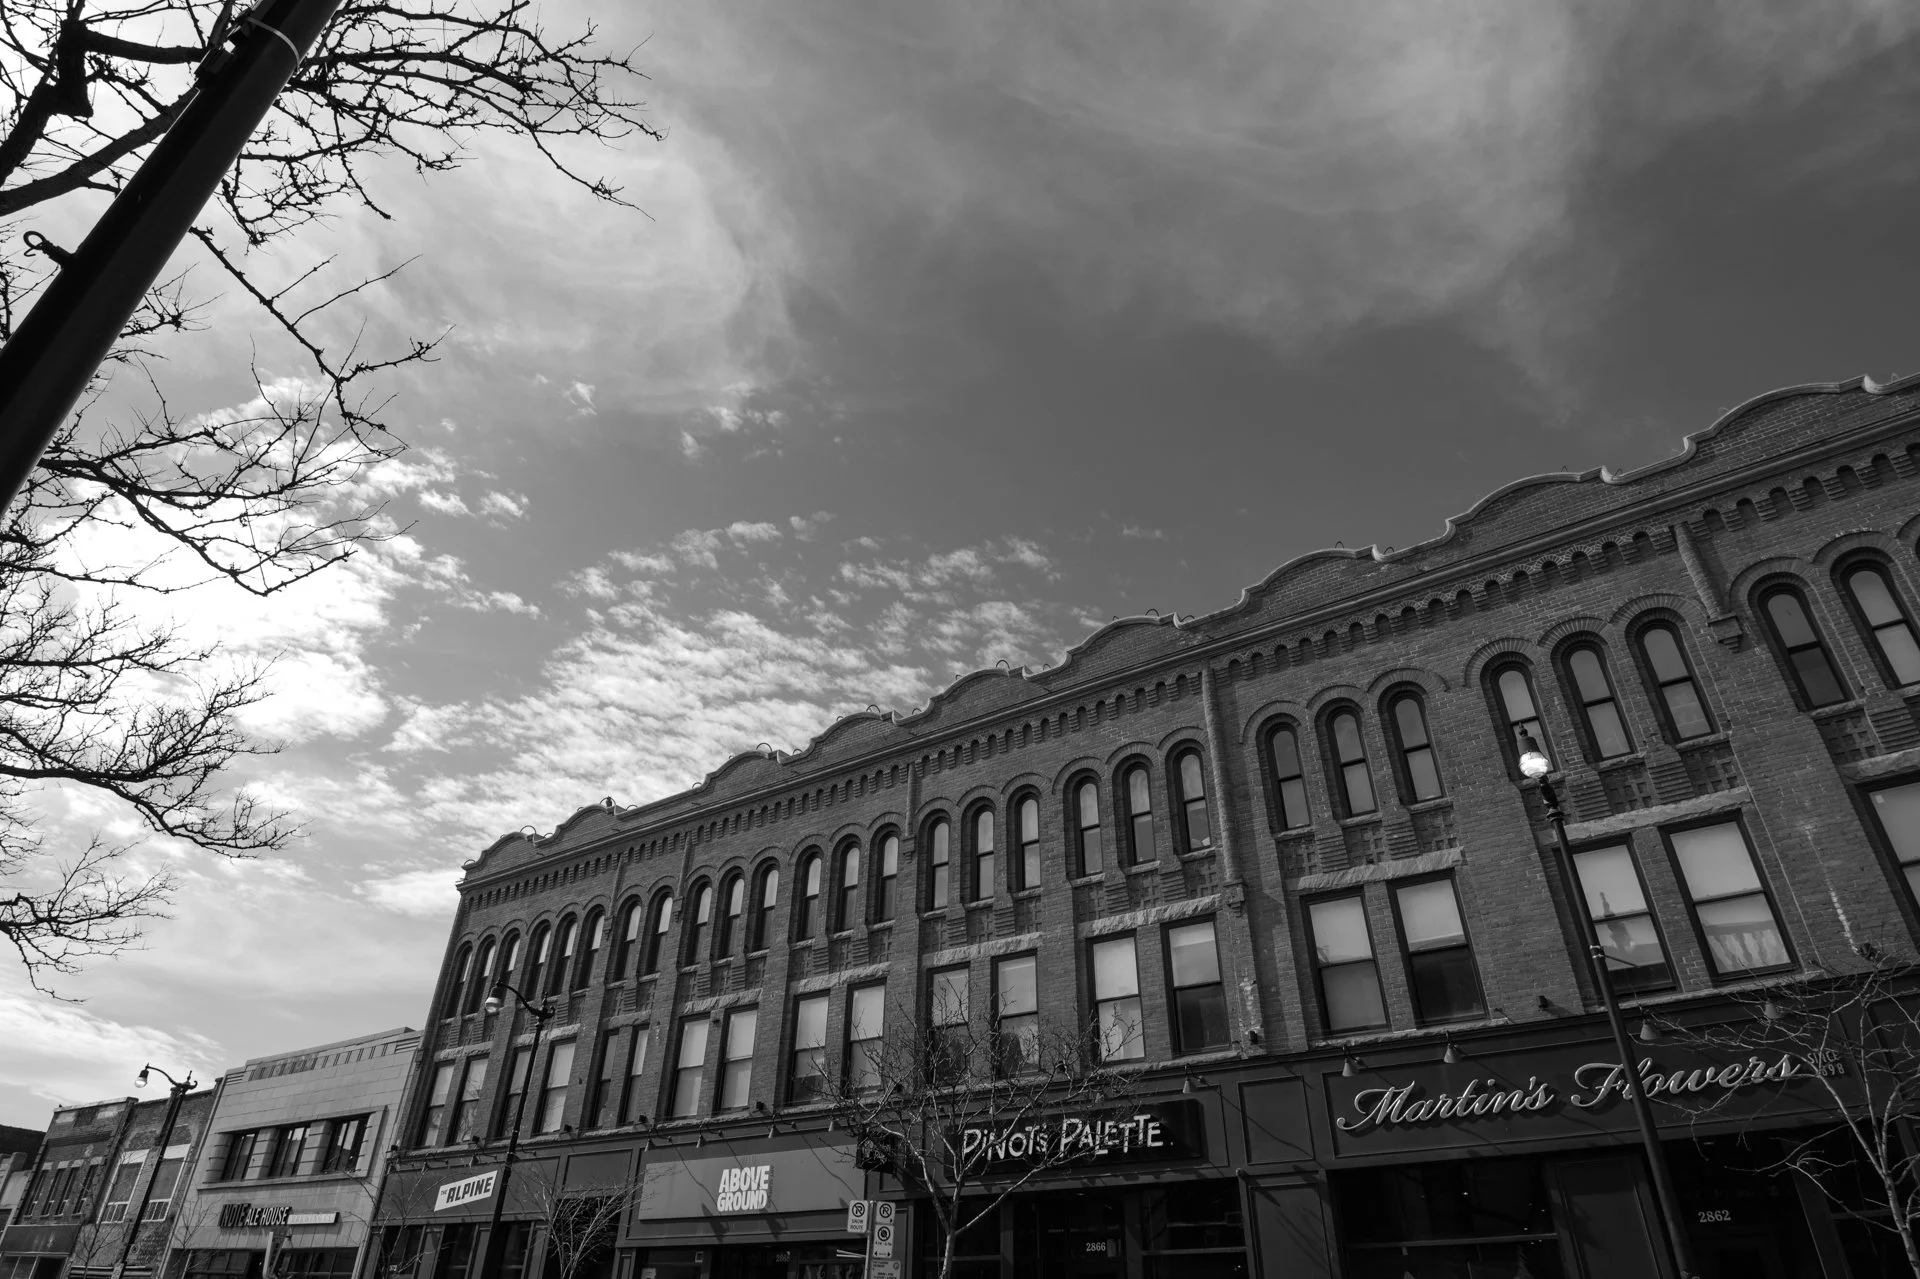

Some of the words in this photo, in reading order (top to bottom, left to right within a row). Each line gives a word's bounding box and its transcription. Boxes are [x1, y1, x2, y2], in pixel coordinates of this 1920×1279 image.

[1817, 1063, 1845, 1077] 898
[1336, 1075, 1555, 1130] Martin's
[1570, 1054, 1801, 1107] Flowers
[440, 1188, 448, 1196] THE
[446, 1176, 493, 1204] ALPINE
[718, 1165, 771, 1193] ABOVE
[717, 1190, 768, 1212] GROUND
[218, 1203, 251, 1227] INDIE
[244, 1208, 261, 1225] ALE
[260, 1206, 291, 1225] HOUSE
[1697, 1209, 1732, 1223] 2862
[1085, 1242, 1106, 1252] 2866
